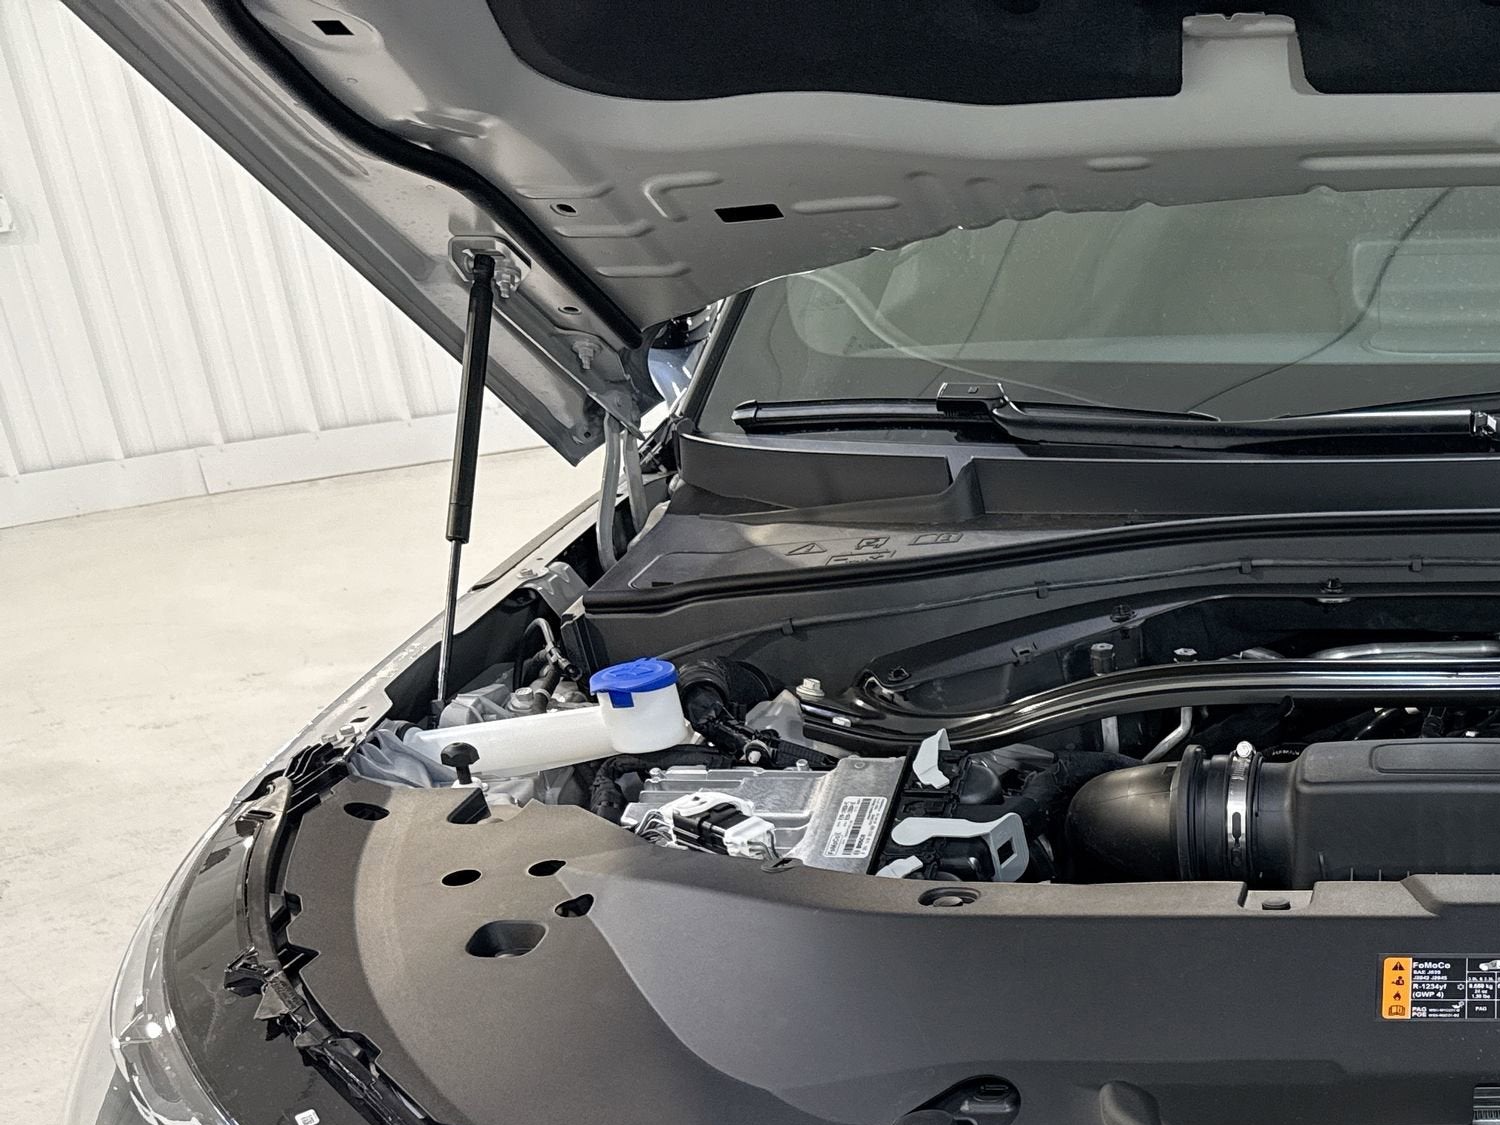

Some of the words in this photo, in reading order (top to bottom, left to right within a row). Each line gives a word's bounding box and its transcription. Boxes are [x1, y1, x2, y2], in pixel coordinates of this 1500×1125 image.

[1412, 961, 1451, 969] FoMoCo
[1412, 983, 1447, 991] R-1234yf
[1436, 991, 1444, 999] 4)
